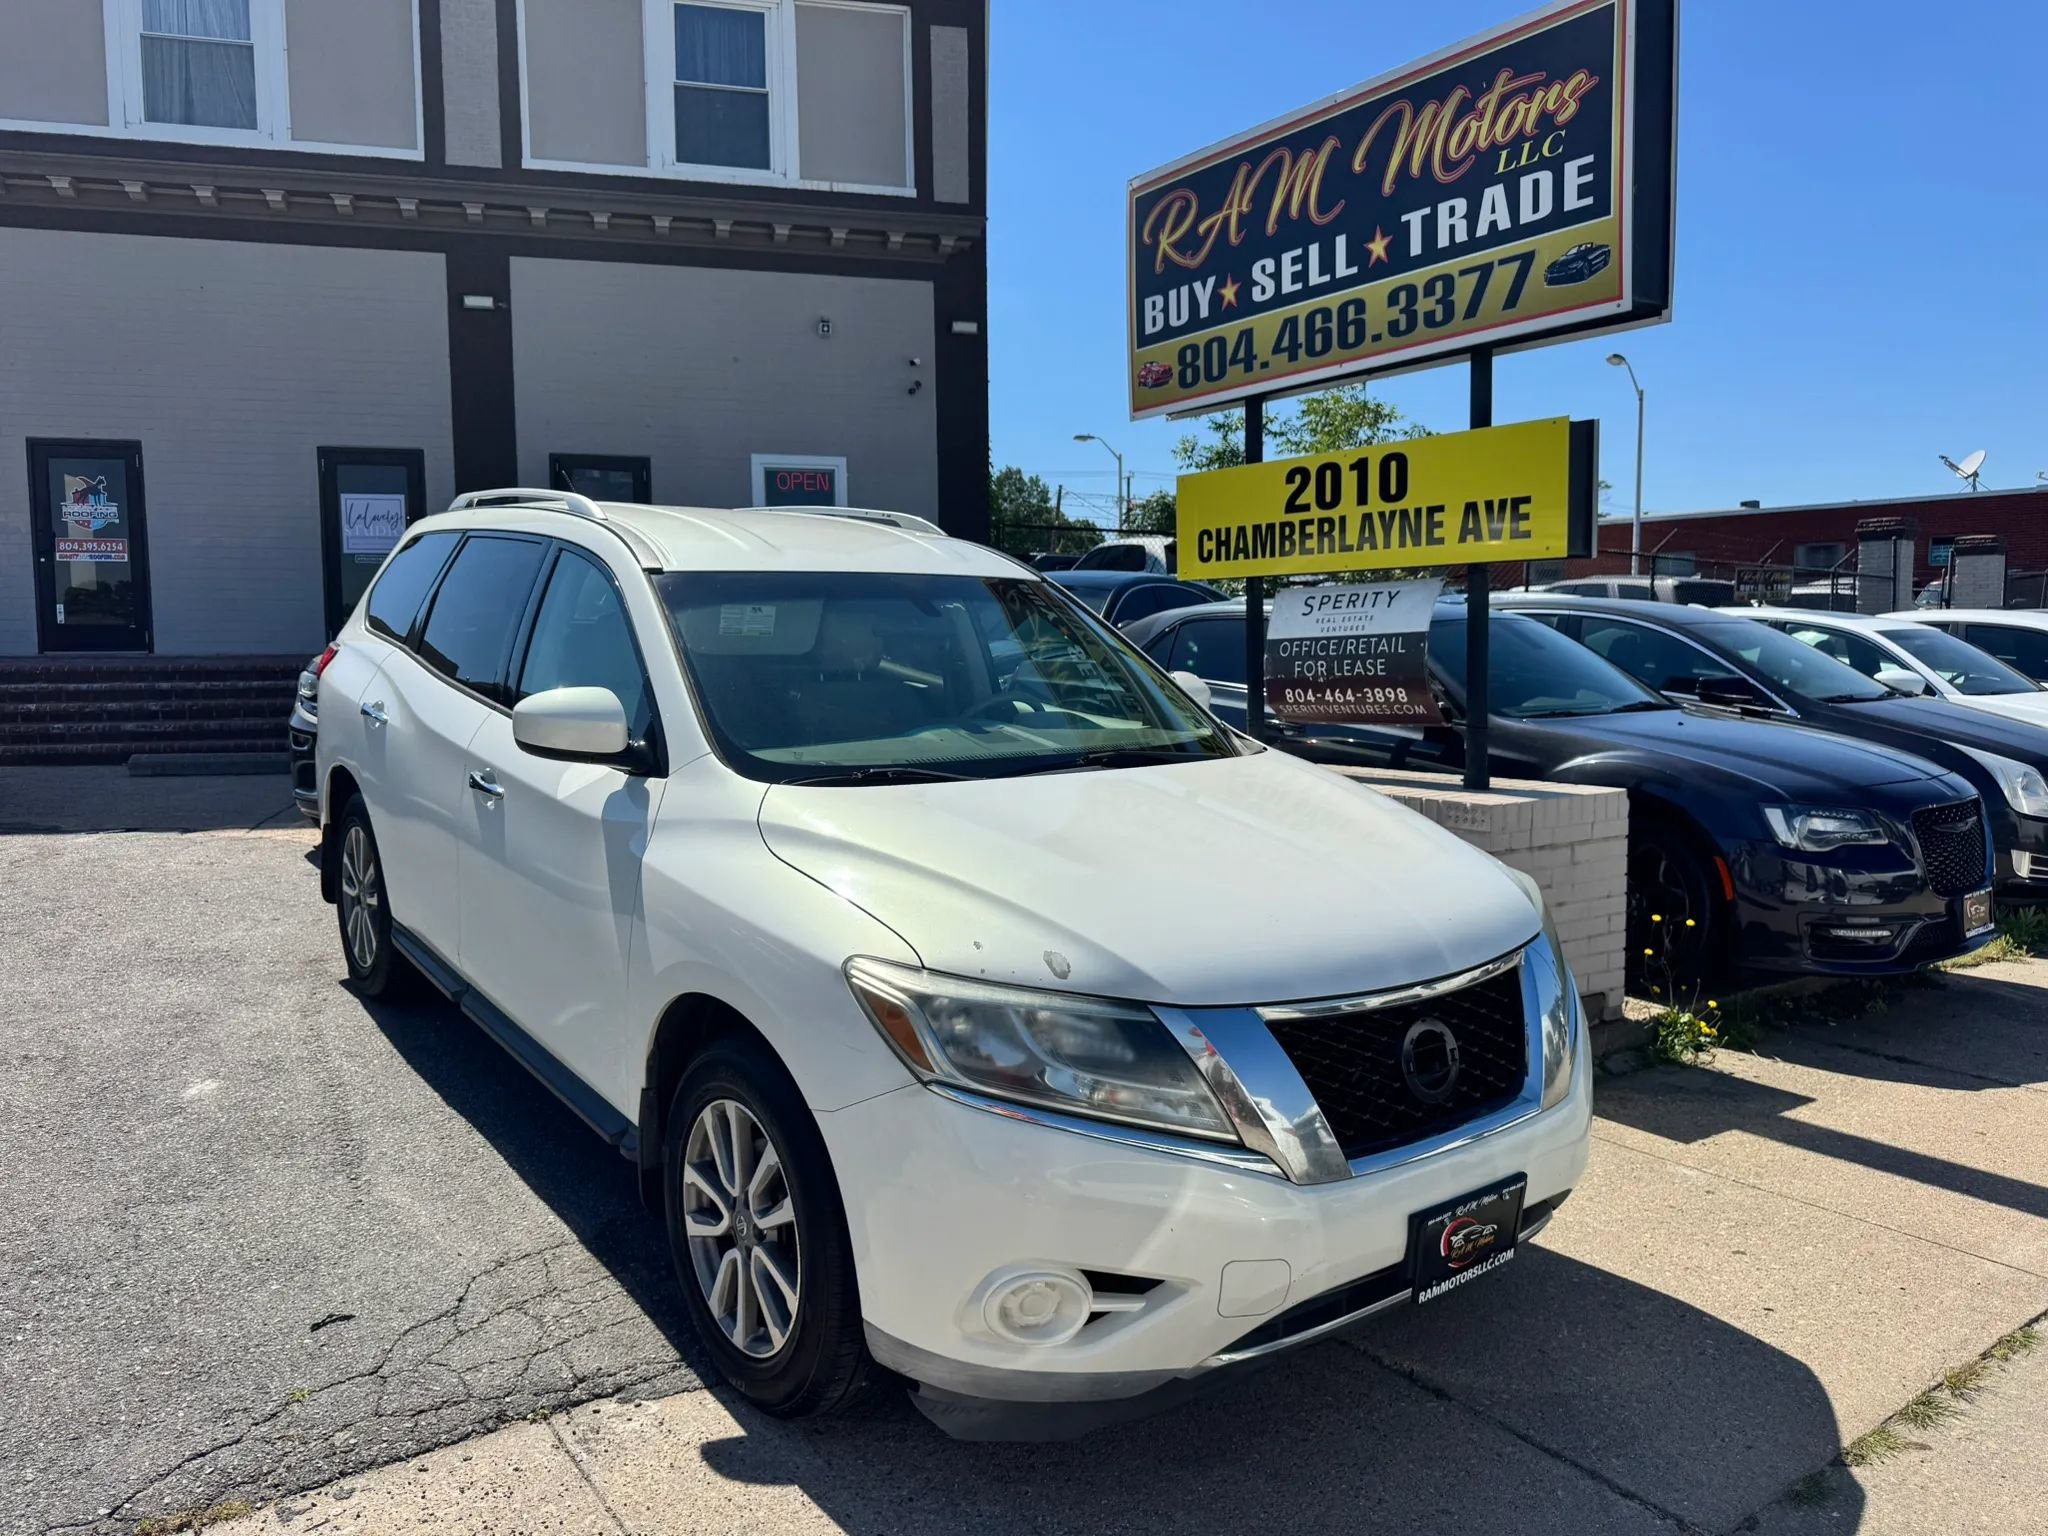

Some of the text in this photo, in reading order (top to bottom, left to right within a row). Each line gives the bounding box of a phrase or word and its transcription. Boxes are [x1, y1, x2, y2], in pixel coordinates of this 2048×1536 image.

[1495, 129, 1566, 175] LLC
[1143, 68, 1599, 275] RAM Motors
[1144, 154, 1595, 336] BUY SELL TRADE
[1178, 249, 1537, 390] 804.466.3377
[776, 471, 829, 491] OPEN
[1284, 452, 1409, 515] 2010
[1197, 495, 1532, 563] CHAMBERLAYNE AVE
[59, 542, 123, 552] 804.395.6254
[1301, 590, 1401, 616] SPERITY
[1320, 625, 1365, 633] VENTURES
[1341, 615, 1374, 623] ESTATE
[1279, 637, 1406, 657] OFFICE/RETAIL
[1294, 659, 1387, 678] FOR LEASE
[1285, 687, 1408, 703] 804-464-3898
[1279, 704, 1428, 715] SPERITYVENTURES.COM
